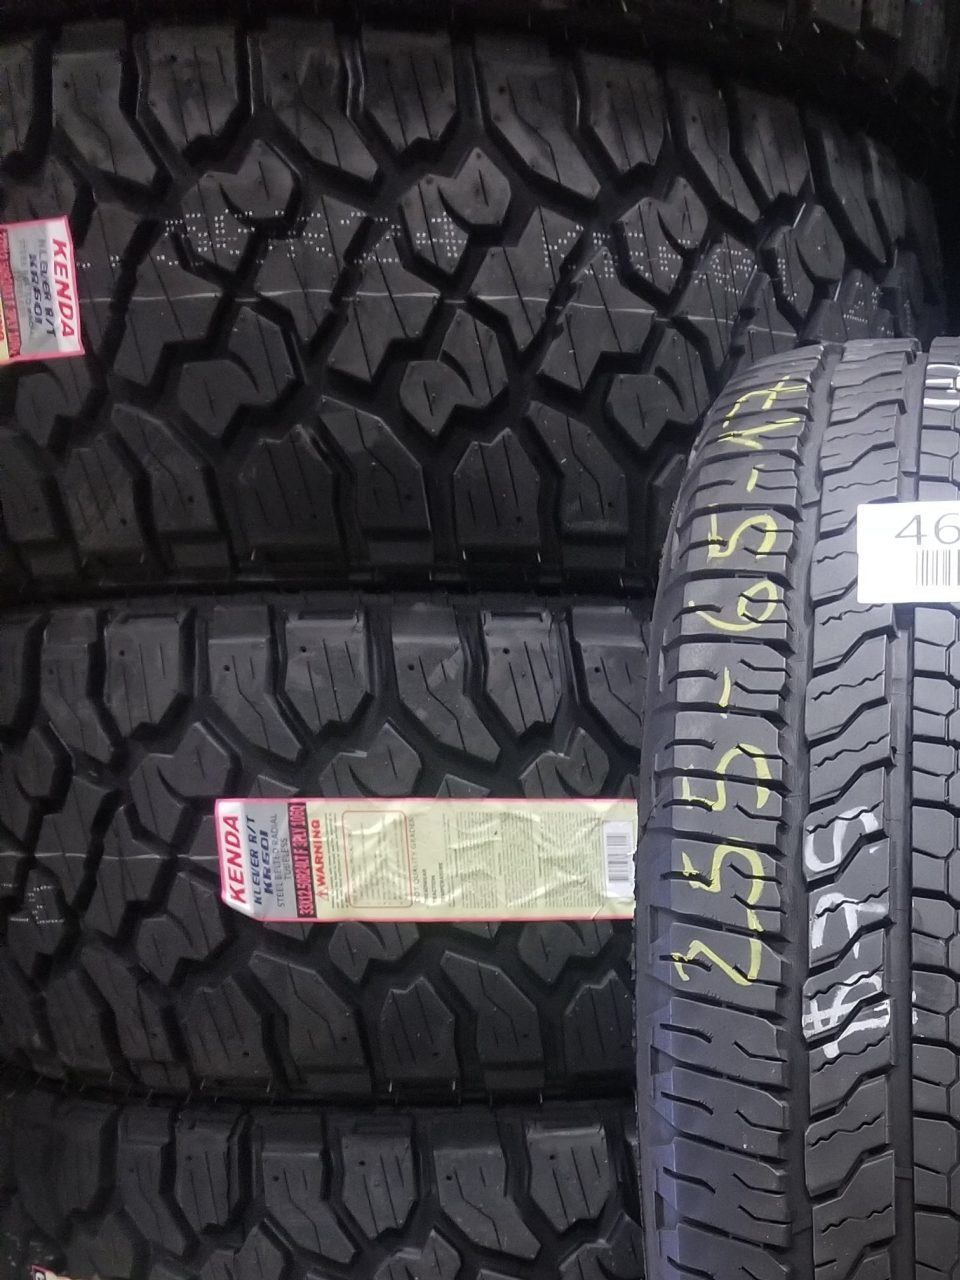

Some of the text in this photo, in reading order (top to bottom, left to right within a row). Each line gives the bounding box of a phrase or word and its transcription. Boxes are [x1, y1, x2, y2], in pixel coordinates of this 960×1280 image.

[28, 253, 43, 325] KR601
[44, 307, 57, 338] R/T
[52, 238, 75, 337] KENDA
[223, 815, 246, 904] KENDA
[246, 816, 262, 904] KLEVER R/T
[260, 829, 273, 895] KR601
[270, 814, 285, 907] STEEL BELTED RADIAL
[280, 837, 291, 880] TUBELESS
[311, 819, 326, 886] WARNING
